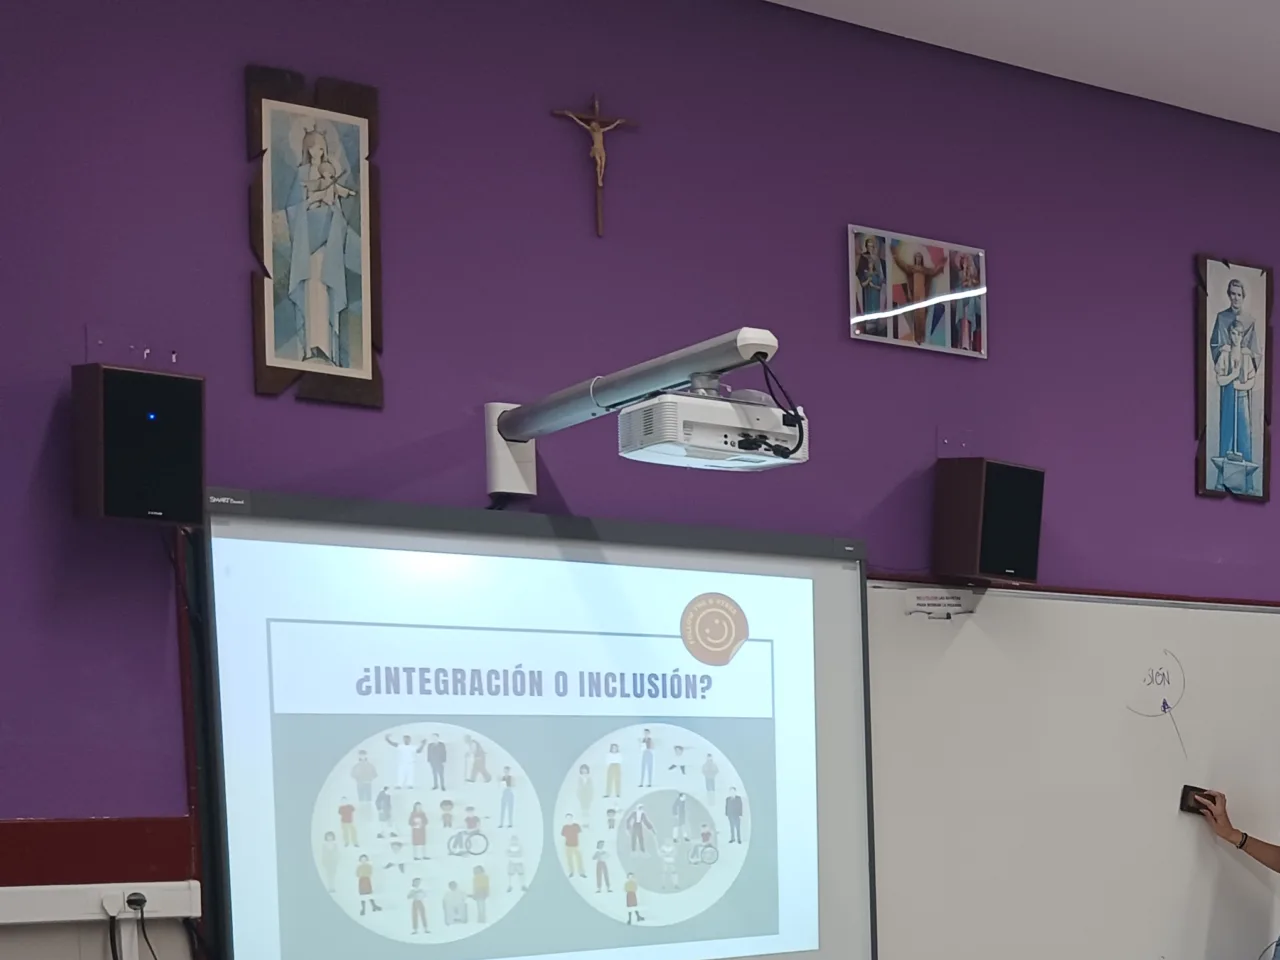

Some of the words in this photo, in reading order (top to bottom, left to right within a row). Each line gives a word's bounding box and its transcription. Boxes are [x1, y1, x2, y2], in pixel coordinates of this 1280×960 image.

[356, 663, 544, 697] ¿INTEGRACIÓN
[554, 671, 569, 697] O
[579, 668, 713, 699] INCLUSIÓN?
